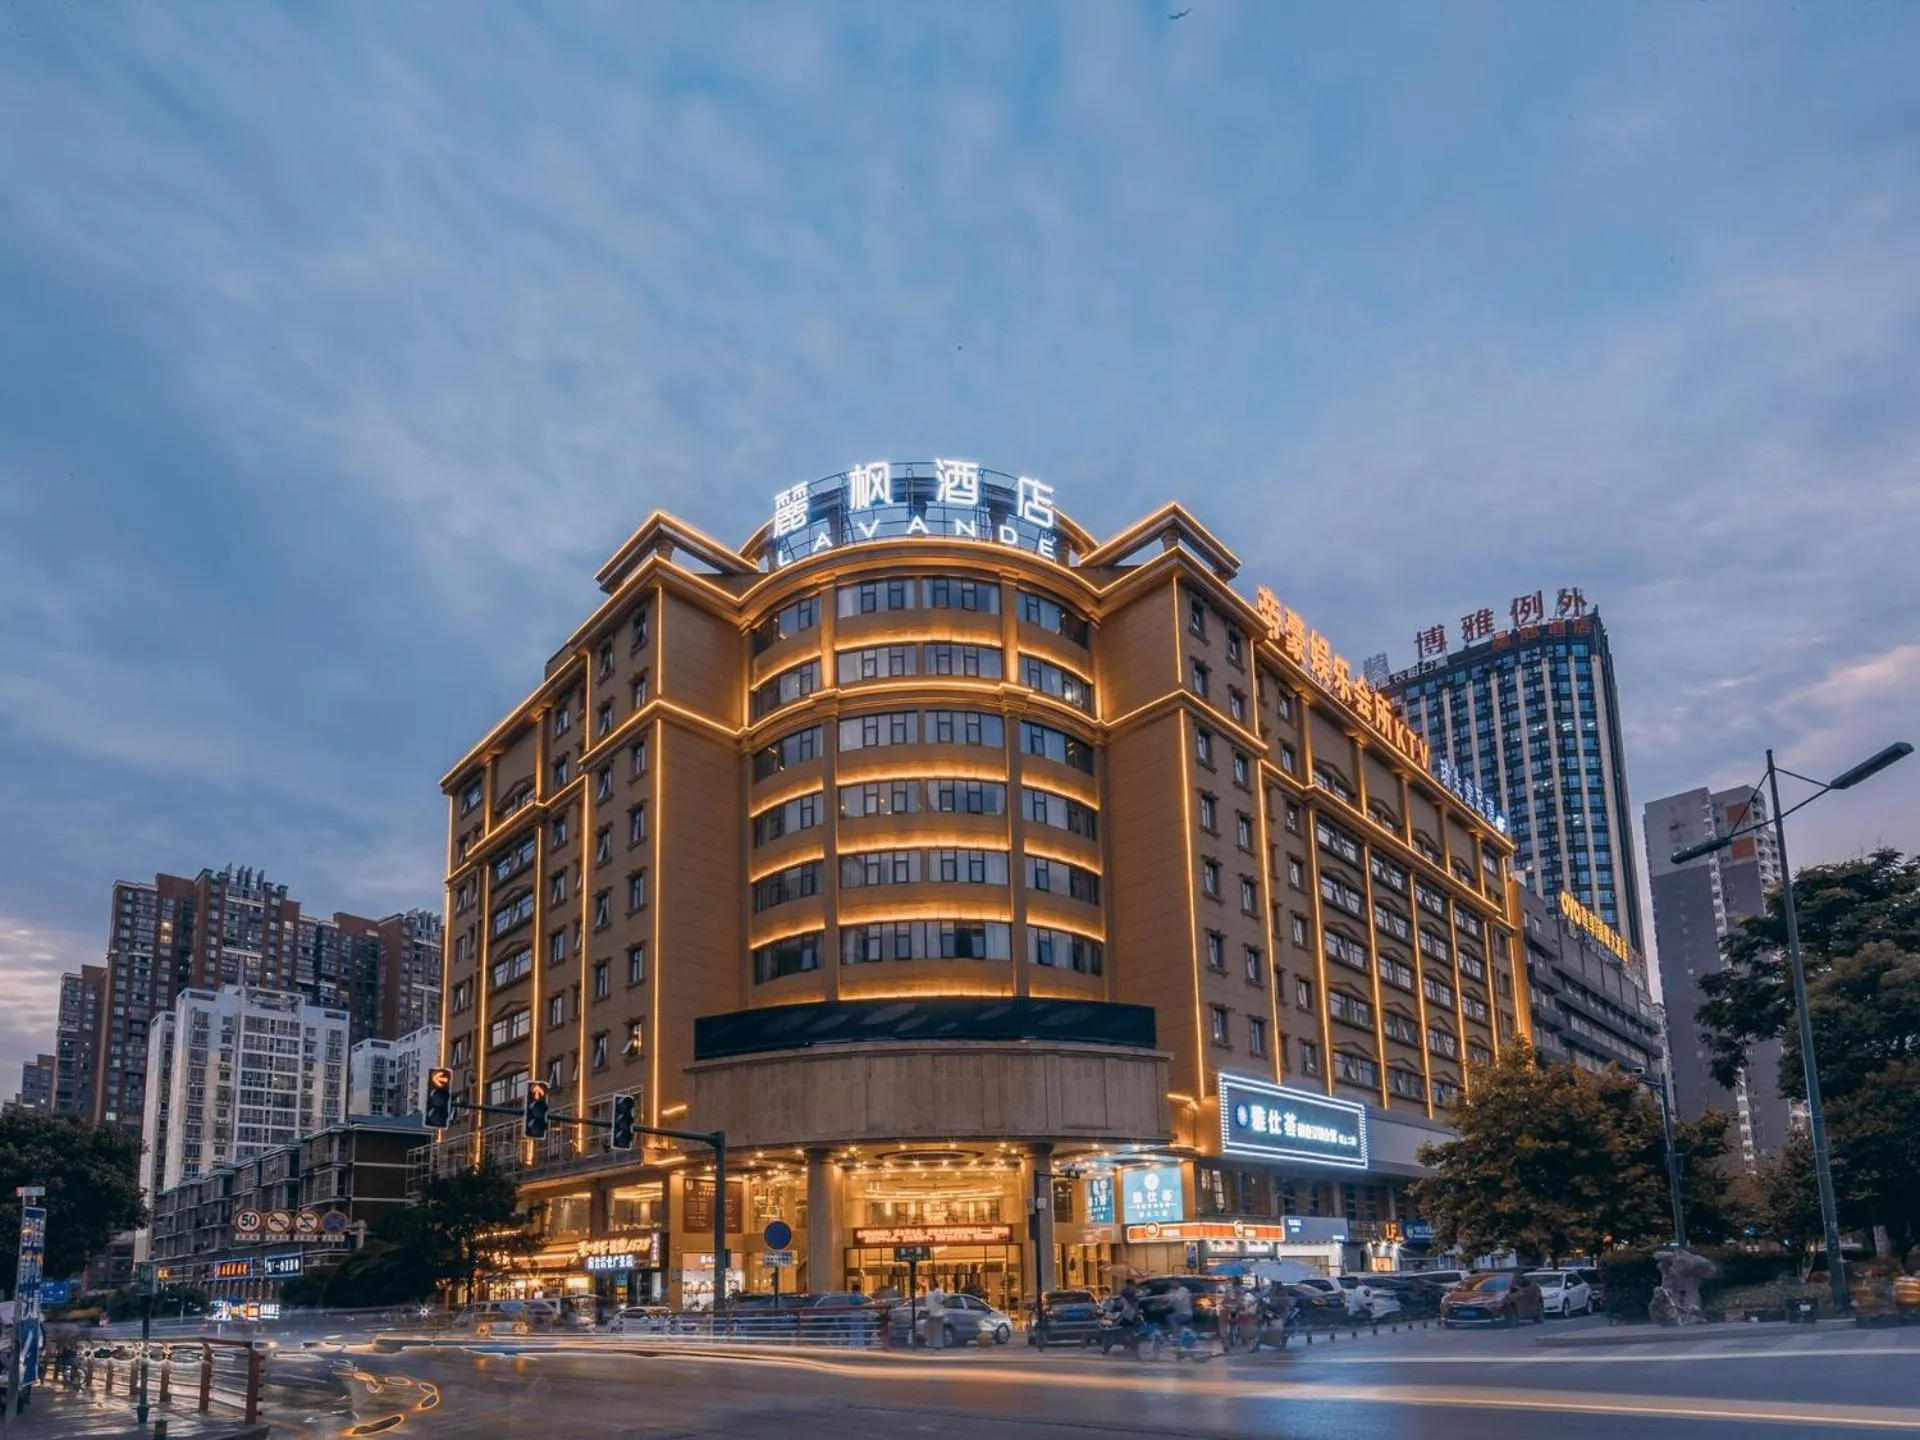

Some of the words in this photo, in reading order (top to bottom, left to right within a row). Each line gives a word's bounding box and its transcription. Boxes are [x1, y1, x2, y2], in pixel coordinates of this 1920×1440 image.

[777, 515, 1056, 567] LAVANDE
[1414, 587, 1587, 659] 博雅例外
[241, 1214, 258, 1227] 50
